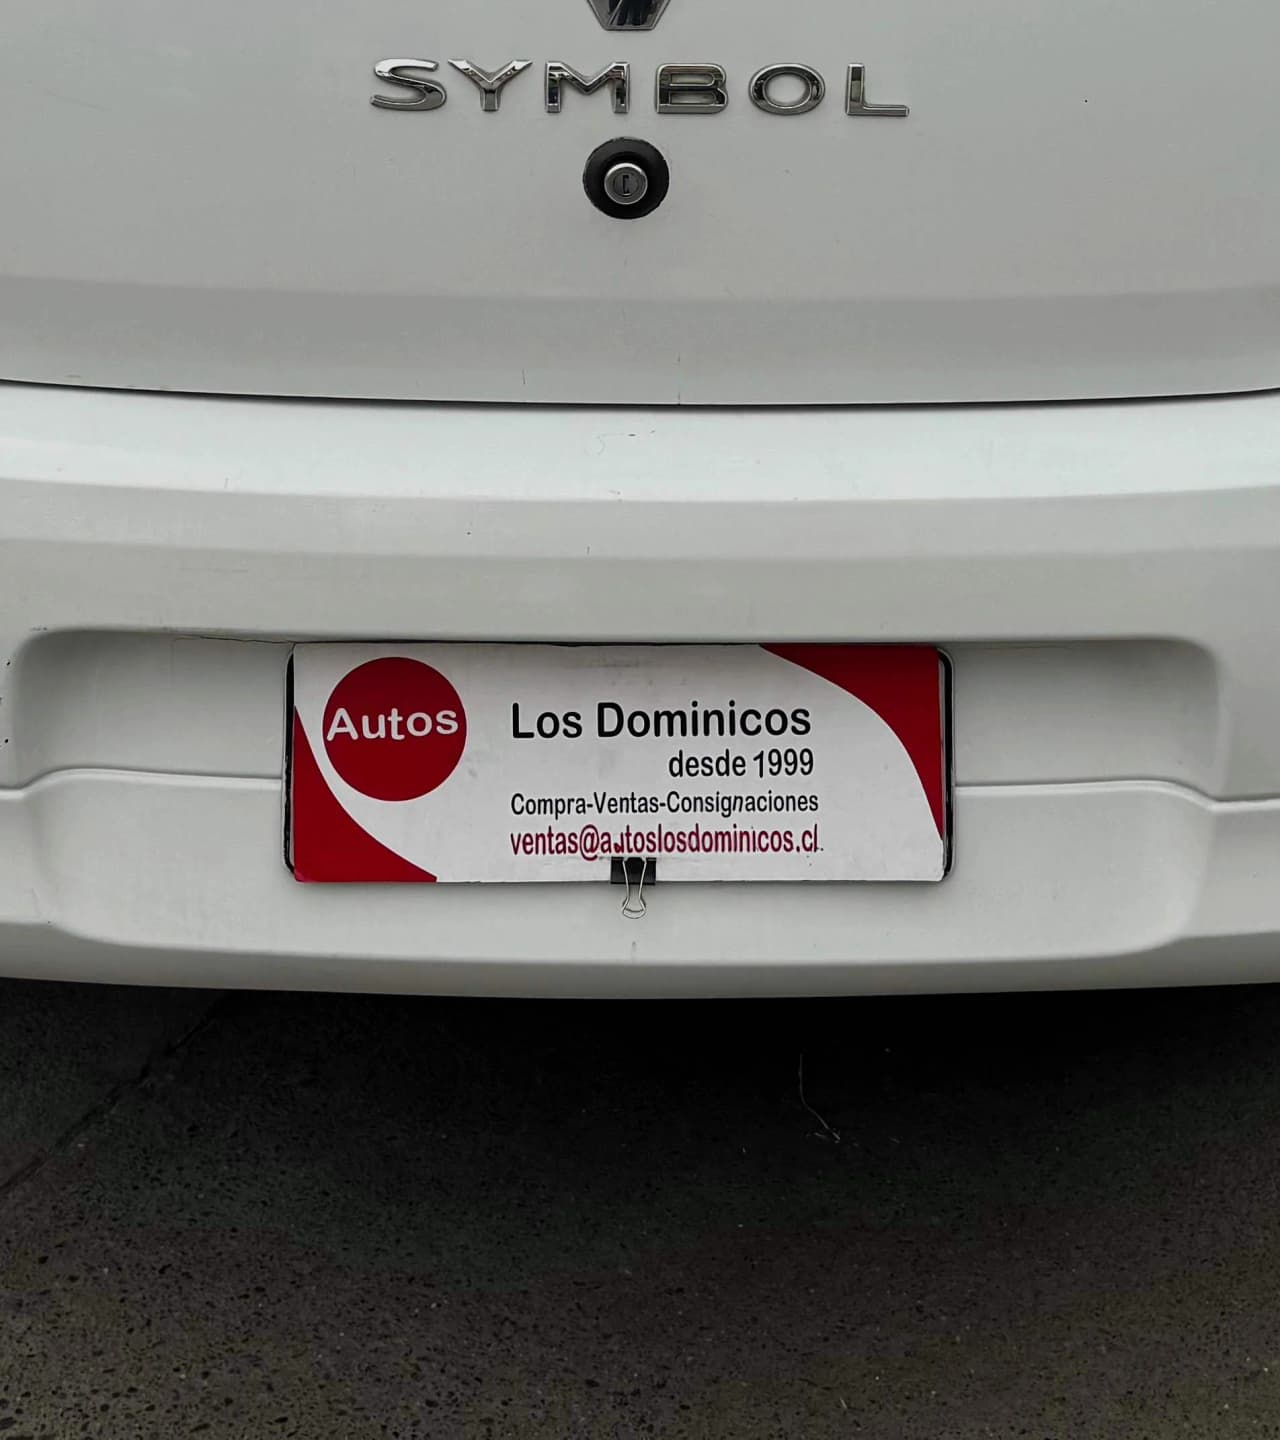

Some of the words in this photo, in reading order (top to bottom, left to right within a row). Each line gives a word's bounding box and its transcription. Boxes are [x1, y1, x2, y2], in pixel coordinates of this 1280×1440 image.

[369, 57, 911, 117] SYMBOL
[325, 705, 460, 742] Autos
[511, 702, 584, 739] Los
[596, 699, 812, 738] Dominicos
[669, 748, 747, 778] desde
[752, 747, 815, 779] 1999
[510, 789, 820, 821] Compra-Ventas-Consignaciones
